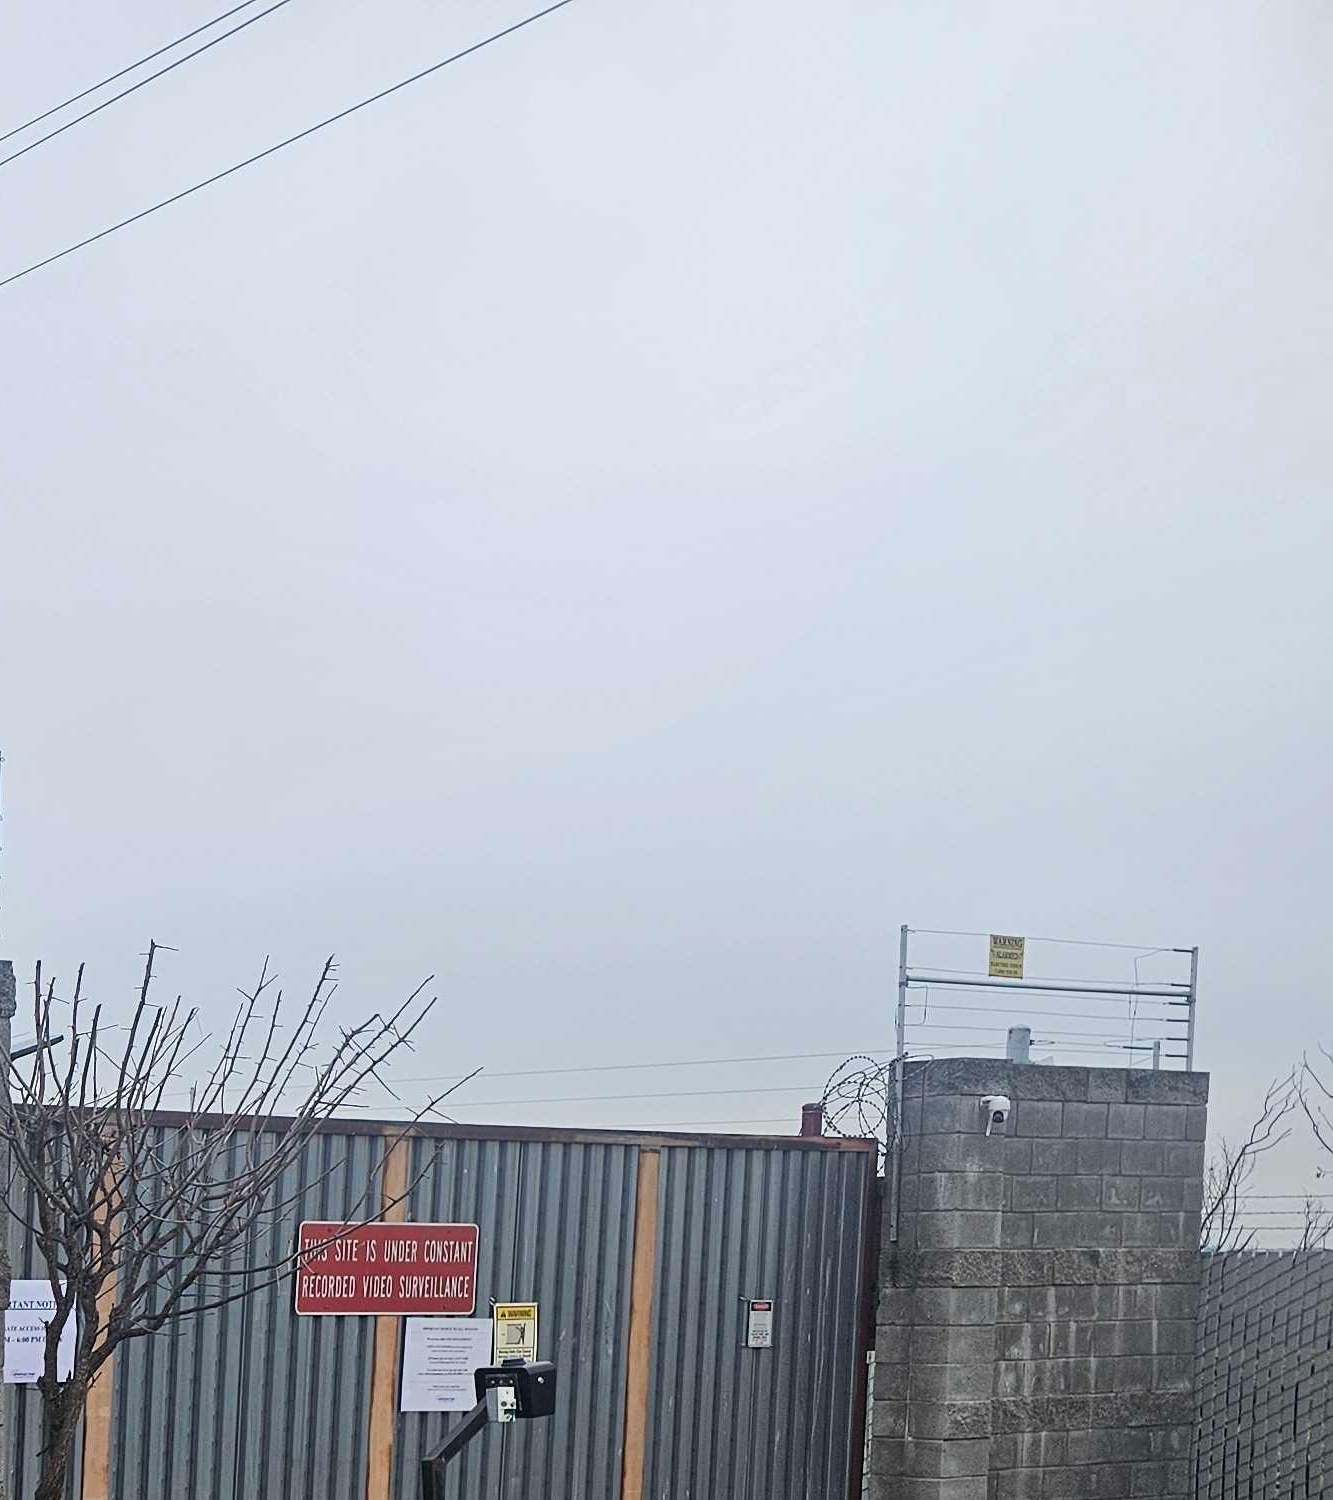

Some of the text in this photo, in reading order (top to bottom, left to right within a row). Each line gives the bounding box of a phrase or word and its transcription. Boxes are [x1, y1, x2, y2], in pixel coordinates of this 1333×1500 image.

[304, 1238, 473, 1264] THIS SITE IS UNDER CONSTANT
[302, 1275, 470, 1299] RECORDED VIDEO SURVEILLANCE
